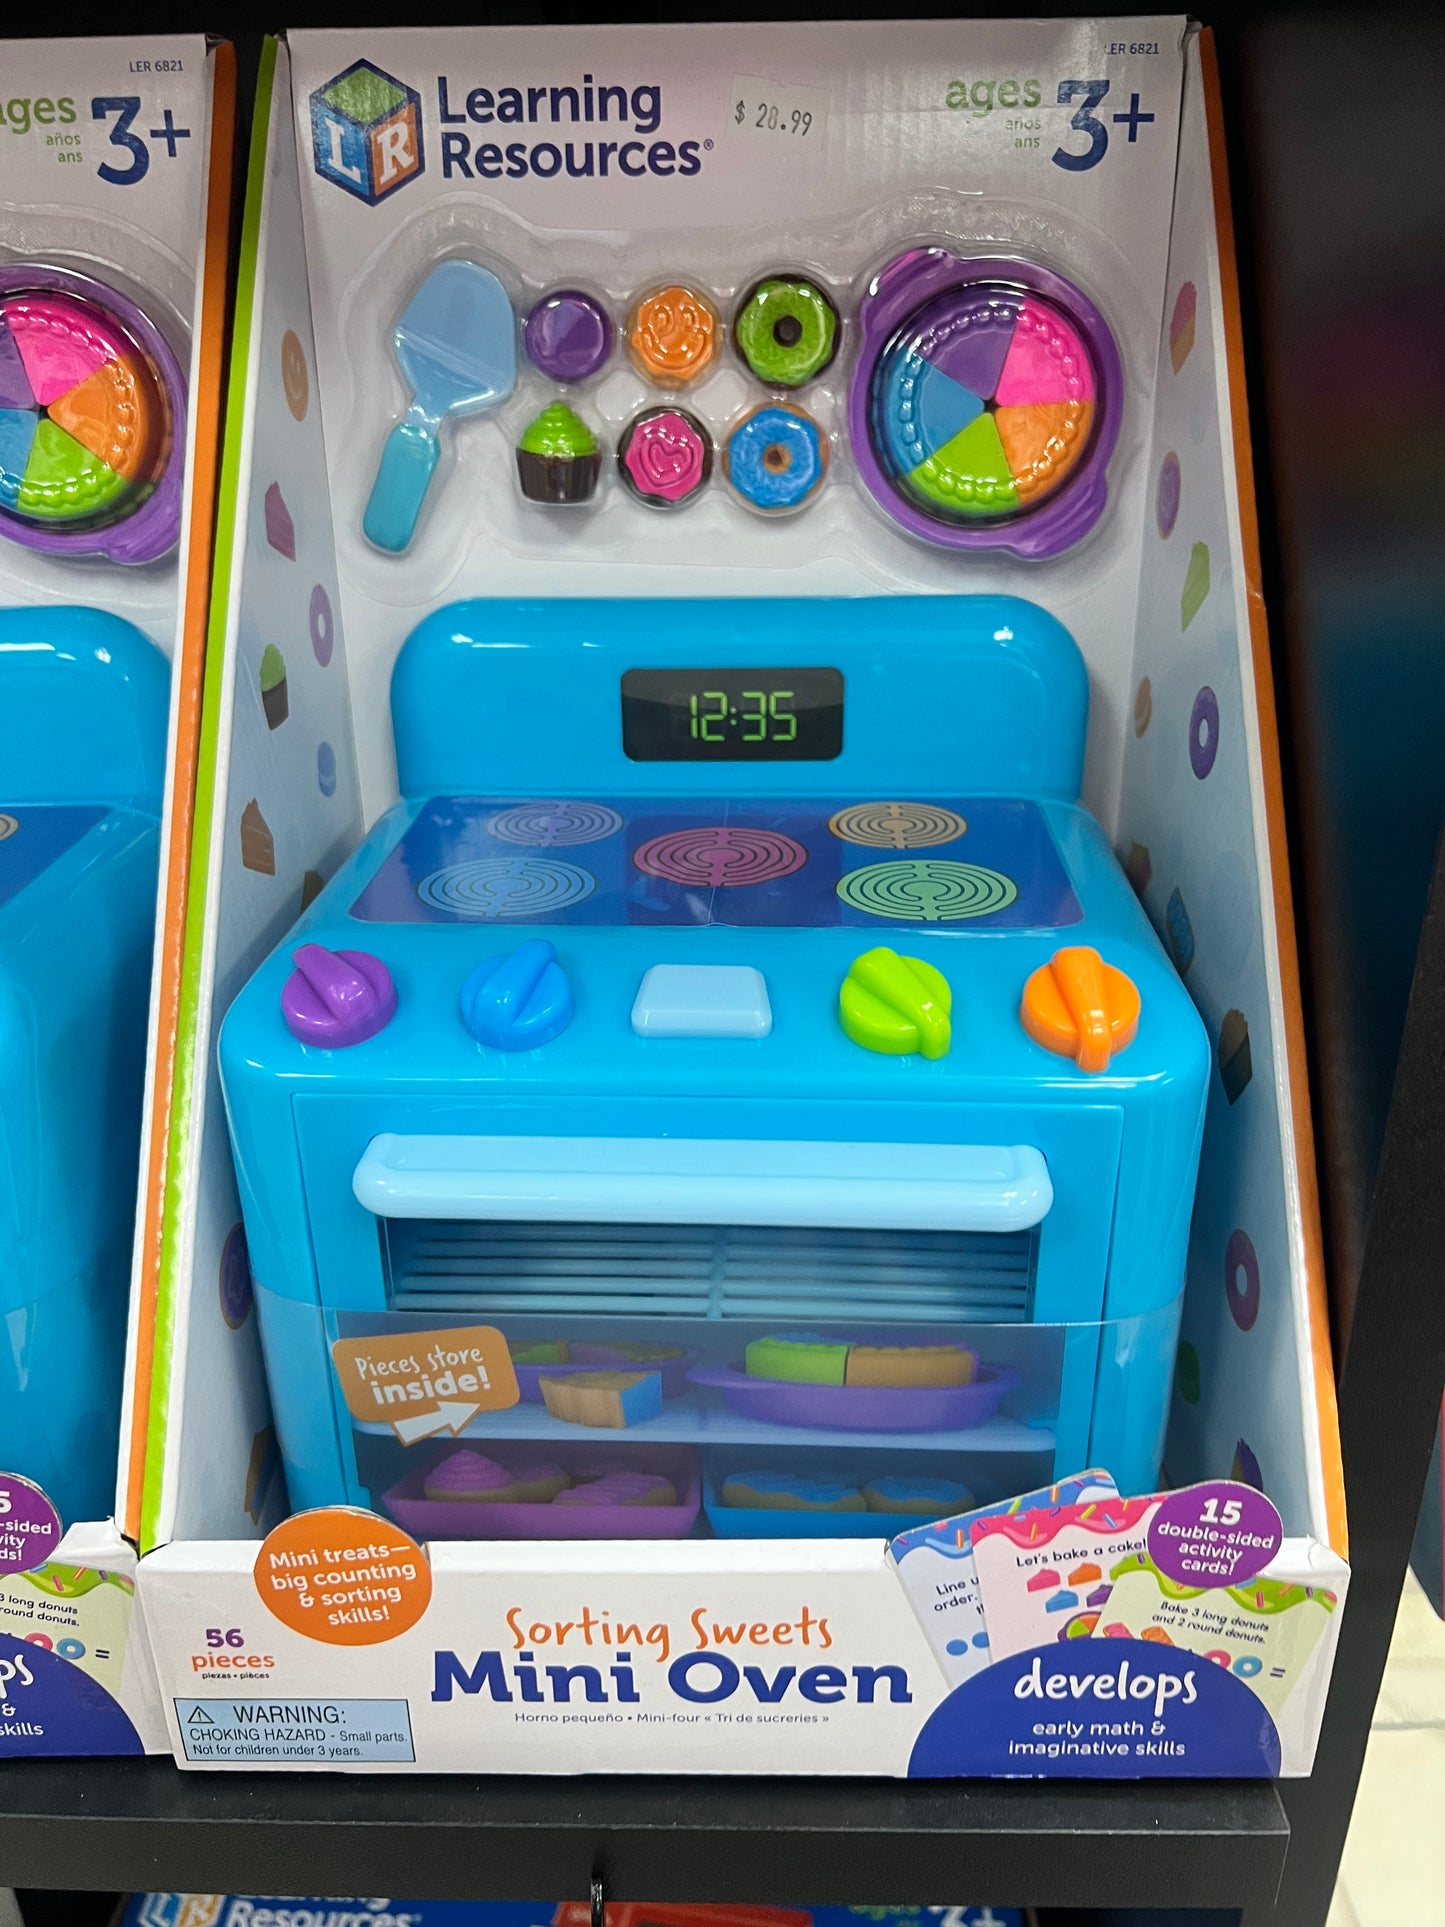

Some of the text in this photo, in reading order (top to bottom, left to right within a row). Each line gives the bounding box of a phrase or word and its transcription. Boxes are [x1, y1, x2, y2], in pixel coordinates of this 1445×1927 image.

[1129, 43, 1159, 55] 6821
[129, 60, 184, 73] LER 6821
[437, 74, 662, 134] Learning
[945, 79, 1042, 117] ages
[734, 100, 813, 136] $ 28.99
[1014, 137, 1041, 148] ans
[58, 151, 83, 163] ans
[690, 691, 797, 742] 12:35
[354, 1344, 483, 1380] Pieces store
[370, 1365, 490, 1405] inside!
[1199, 1497, 1243, 1526] 15
[1157, 1521, 1275, 1550] double-sided
[269, 1549, 319, 1569] Mini
[1016, 1554, 1049, 1568] Let's
[1053, 1549, 1089, 1562] bake
[1108, 1538, 1147, 1554] cake!
[1178, 1541, 1244, 1564] activity
[271, 1563, 417, 1592] big counting
[1181, 1558, 1236, 1577] cards!
[298, 1586, 402, 1608] & sorting
[935, 1581, 967, 1596] Line
[9, 1594, 35, 1609] long
[38, 1600, 78, 1615] donuts
[933, 1595, 979, 1612] order.
[37, 1612, 80, 1627] donuts.
[328, 1605, 390, 1625] skills!
[1160, 1601, 1189, 1616] Bake
[1201, 1609, 1228, 1626] long
[1230, 1616, 1270, 1633] donuts
[206, 1628, 245, 1648] 56
[505, 1607, 834, 1663] Sorting Sweets
[1151, 1615, 1176, 1626] and
[1187, 1620, 1224, 1636] round
[1224, 1628, 1266, 1645] donuts.
[191, 1651, 276, 1672] pieces
[202, 1672, 232, 1680] piezas
[431, 1651, 913, 1704] Mini Oven
[1014, 1657, 1198, 1718] develops
[1, 1703, 16, 1717] &
[232, 1706, 347, 1724] WARNING:
[514, 1712, 559, 1723] Horno
[562, 1712, 623, 1724] pequeño
[636, 1712, 701, 1723] Mini-four
[715, 1712, 732, 1723] Tri
[736, 1712, 753, 1723] de
[756, 1713, 818, 1724] sucreries
[189, 1728, 260, 1741] CHOKING
[264, 1729, 327, 1742] HAZARD
[339, 1730, 373, 1742] Small
[375, 1730, 408, 1746] parts.
[1032, 1720, 1167, 1741] early math &
[193, 1744, 364, 1759] Not for children under 3 years.
[1008, 1739, 1186, 1761] imaginative skills
